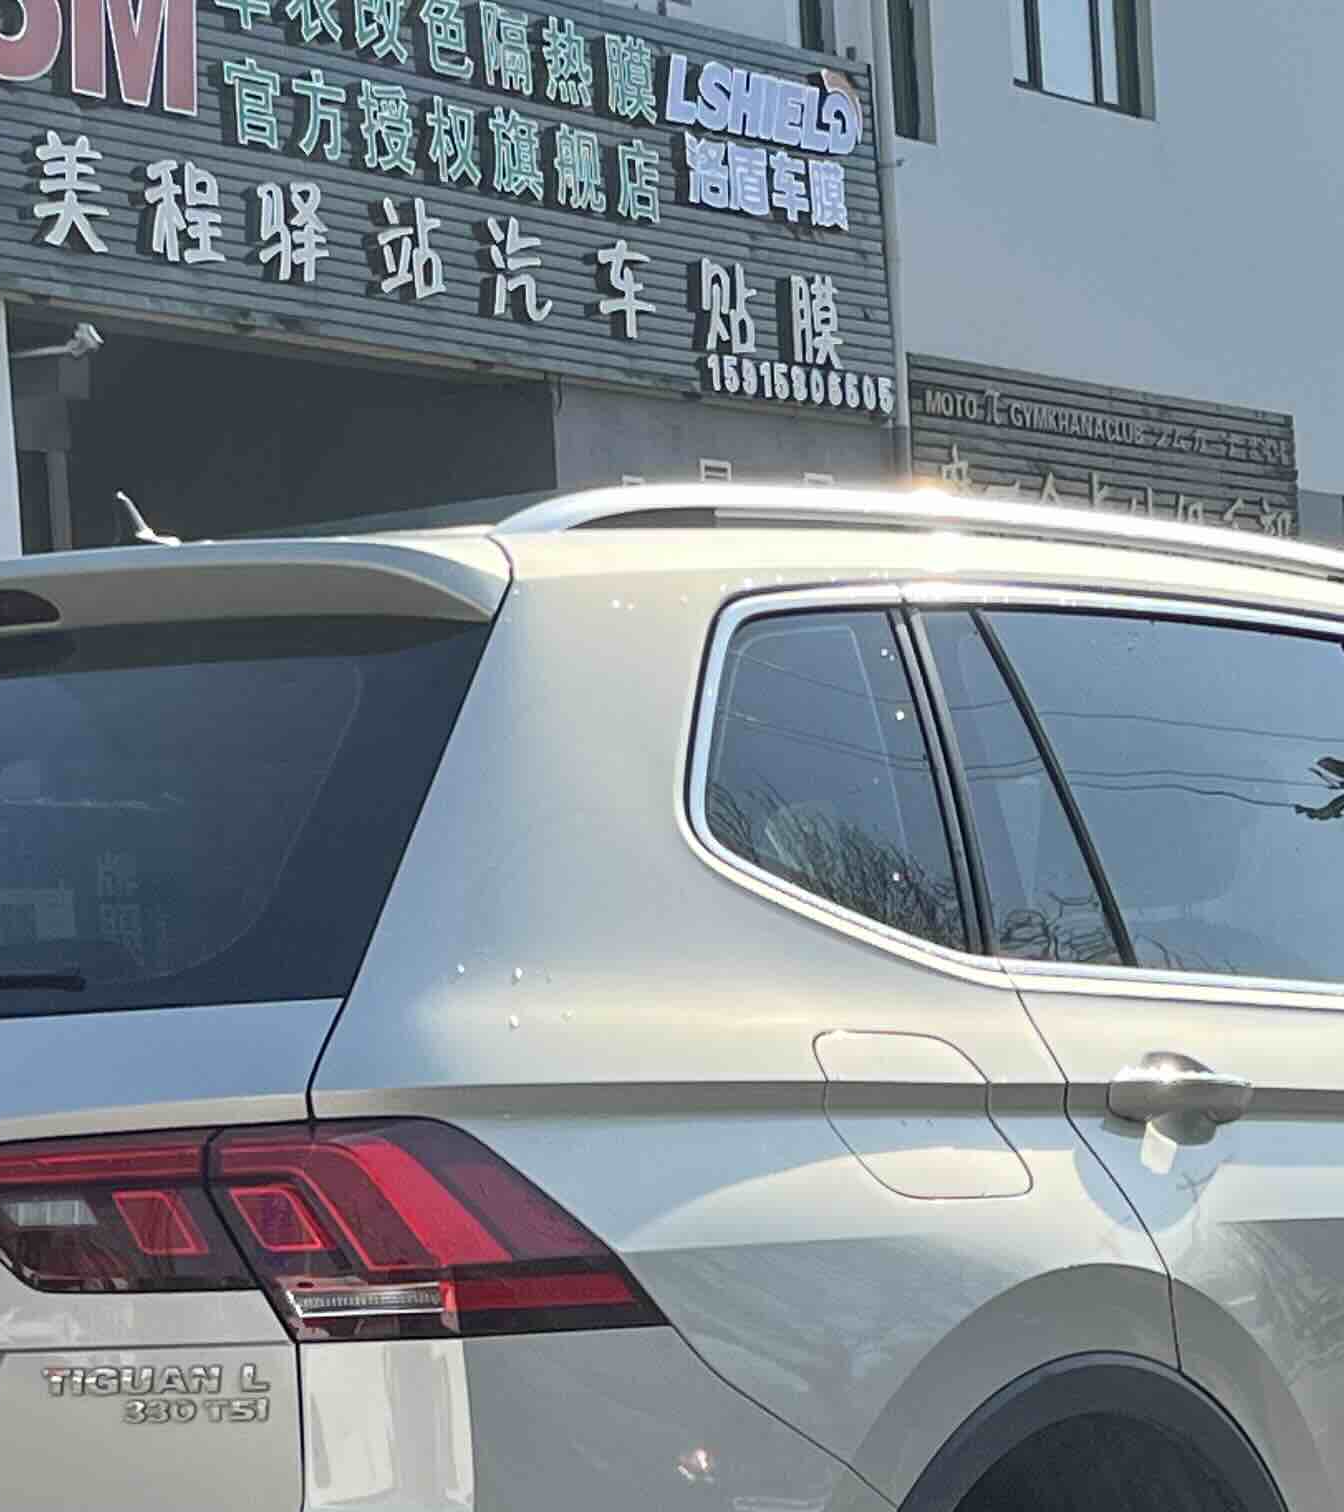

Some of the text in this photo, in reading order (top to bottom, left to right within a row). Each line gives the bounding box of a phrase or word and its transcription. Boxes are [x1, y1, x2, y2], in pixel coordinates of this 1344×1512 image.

[666, 53, 859, 155] LSHIELD
[223, 58, 661, 223] 官方授权旗舰店
[924, 390, 978, 418] MOTO
[42, 1362, 270, 1397] TIGUAN L
[123, 1397, 270, 1424] 330 TSI
